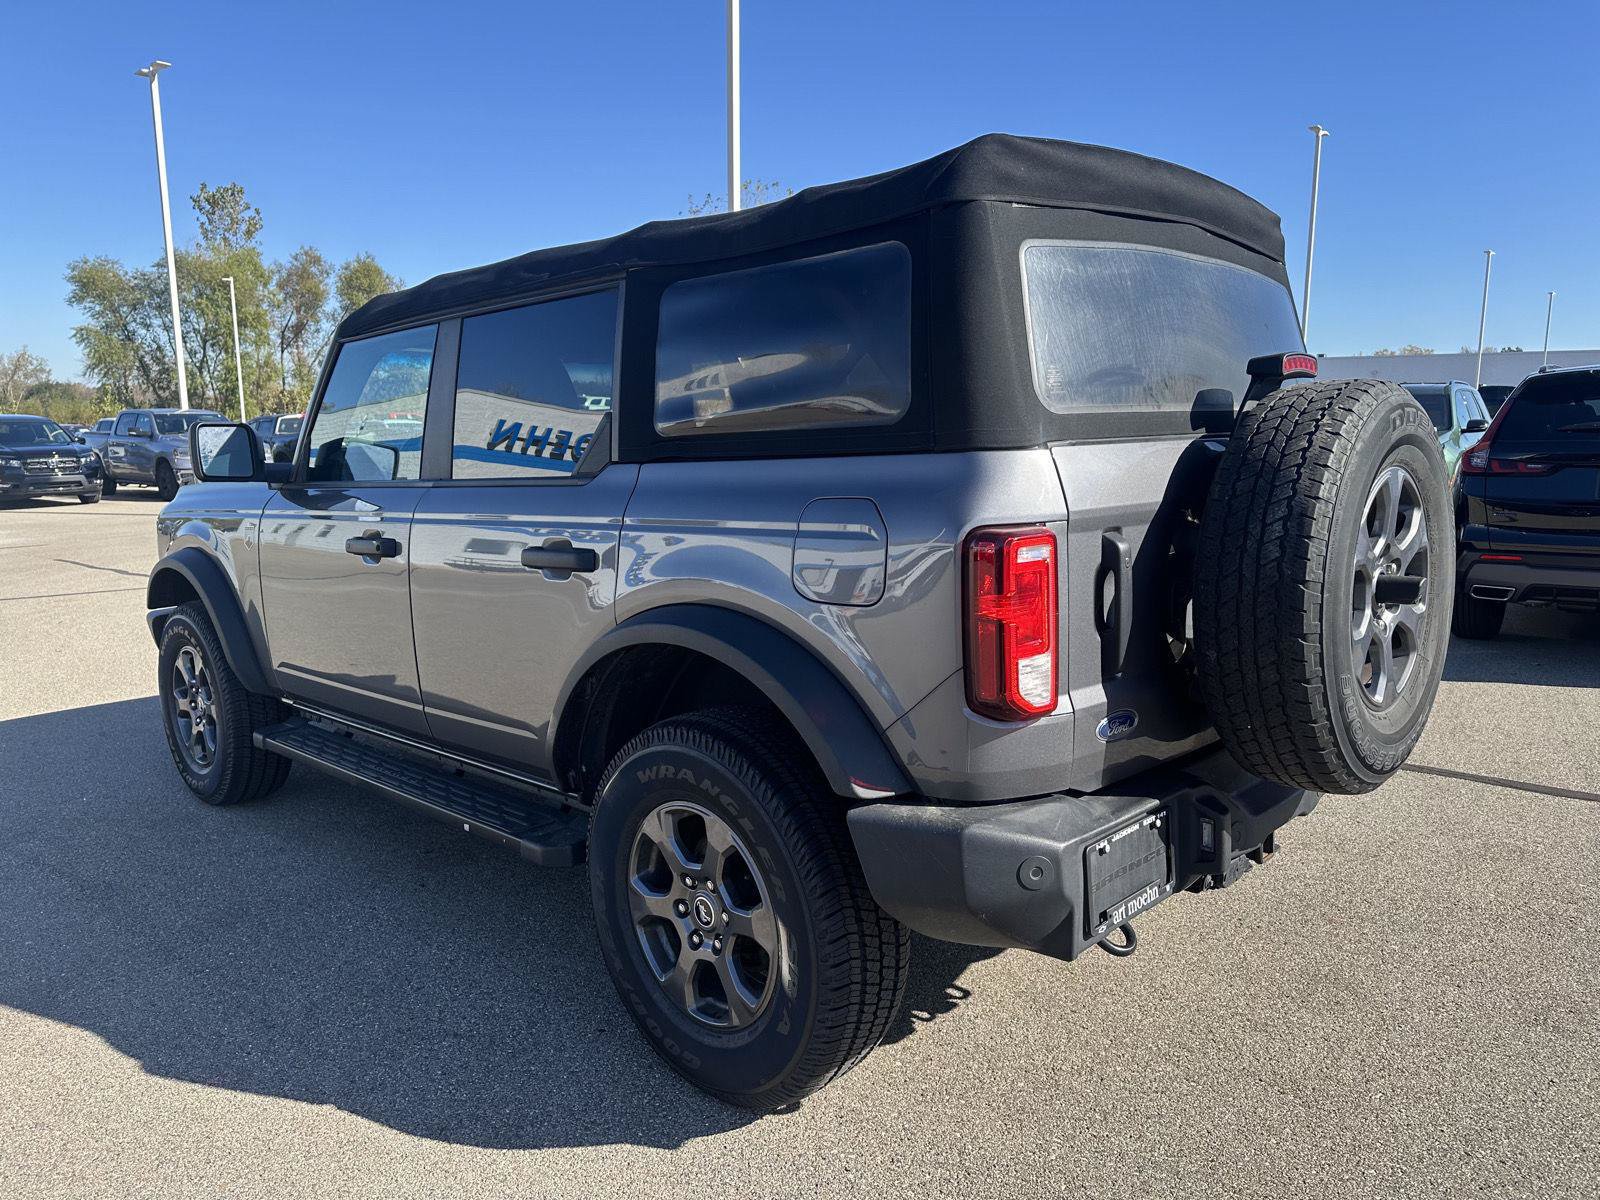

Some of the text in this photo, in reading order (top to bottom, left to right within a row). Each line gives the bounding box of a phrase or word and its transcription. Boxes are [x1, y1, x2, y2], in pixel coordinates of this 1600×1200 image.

[1341, 673, 1420, 772] GESTONE
[637, 763, 787, 904] WRANGLER
[1142, 815, 1156, 827] EXIT
[1112, 886, 1160, 924] art moehn
[592, 866, 702, 1070] GOODY
